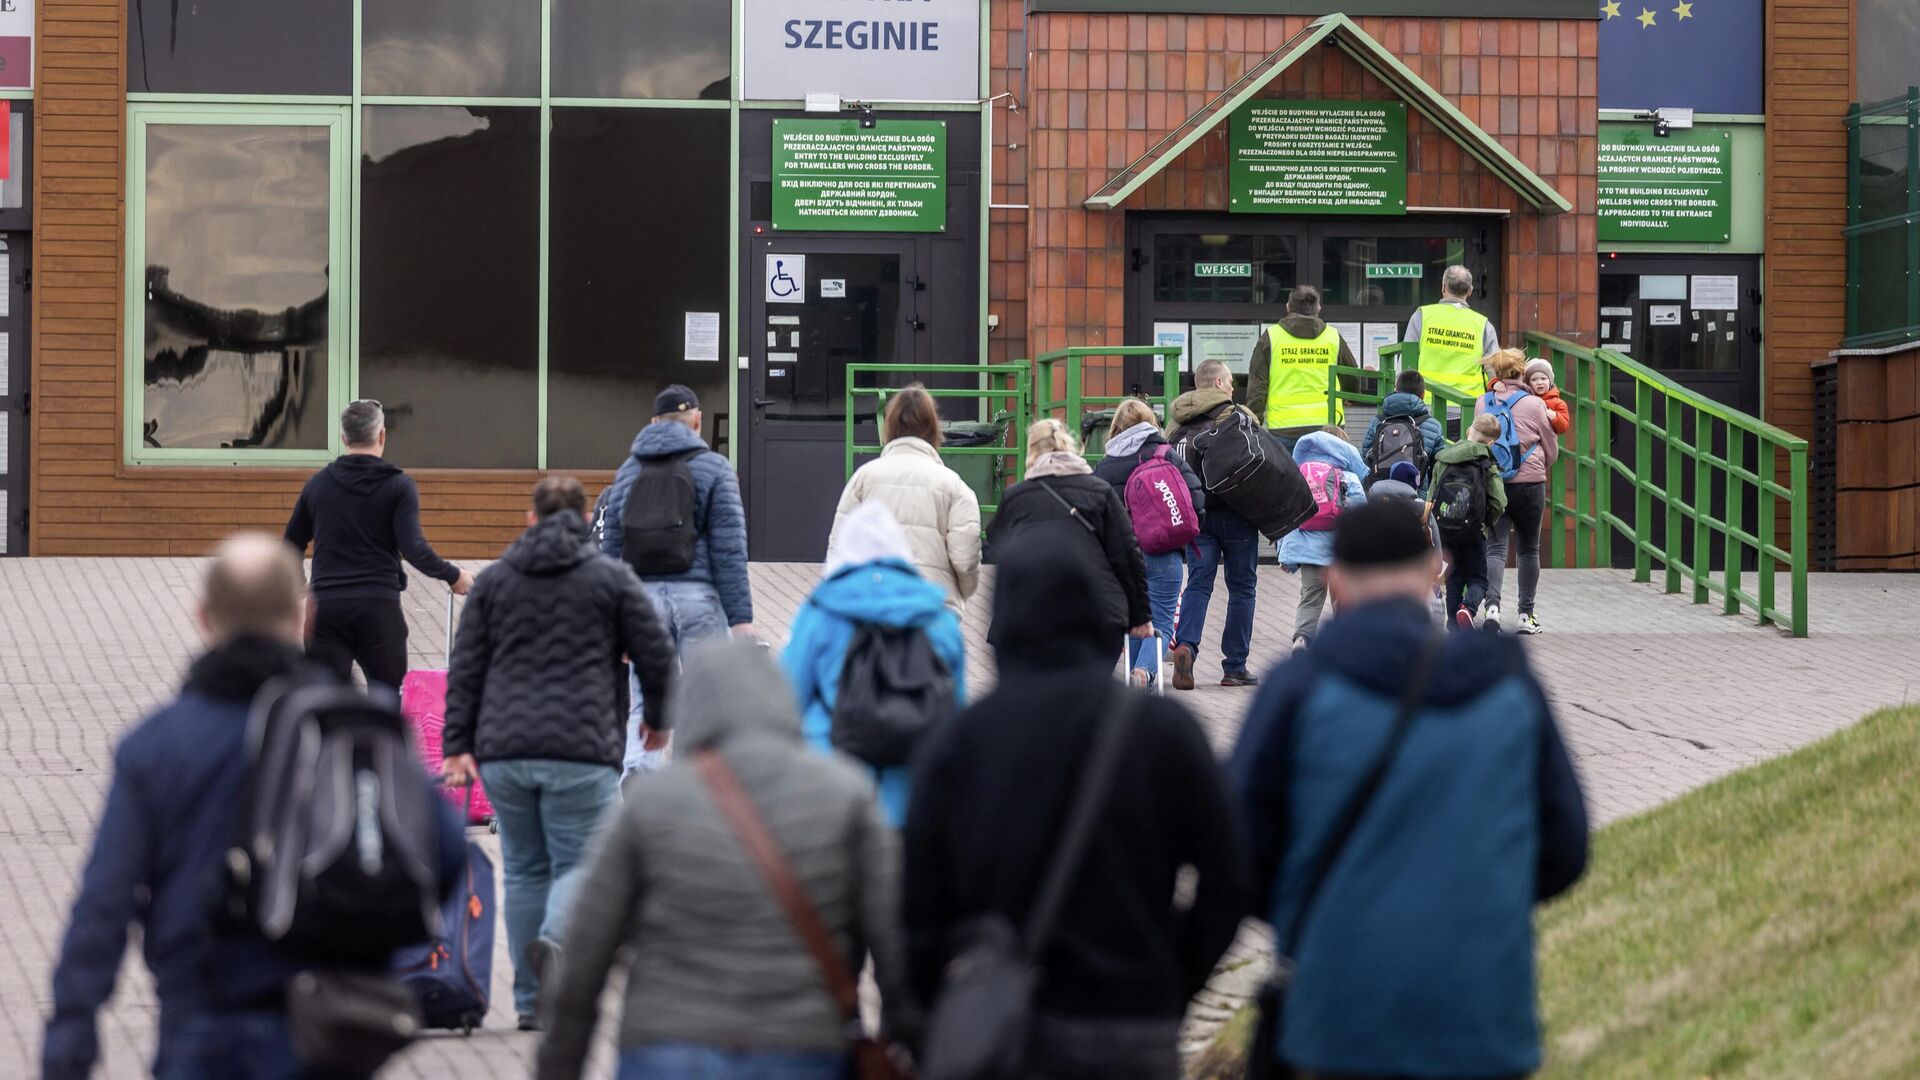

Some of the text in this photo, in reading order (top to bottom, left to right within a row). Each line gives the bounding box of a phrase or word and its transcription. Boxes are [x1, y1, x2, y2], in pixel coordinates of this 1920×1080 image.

[785, 20, 938, 50] SZEGINIE
[783, 133, 813, 141] WEJŚCIE
[860, 135, 900, 143] WYŁĄCZNIE
[856, 144, 886, 152] GRANICĘ
[1646, 145, 1686, 153] WYŁĄCZNIE
[1702, 144, 1720, 152] OSÓB
[1597, 155, 1641, 163] ACZAJĄCYCH
[1642, 156, 1672, 164] GRANICĘ
[1640, 165, 1676, 174] WCHODZIĆ
[1446, 329, 1475, 341] GRANICZNA
[1154, 480, 1184, 527] Reebok
